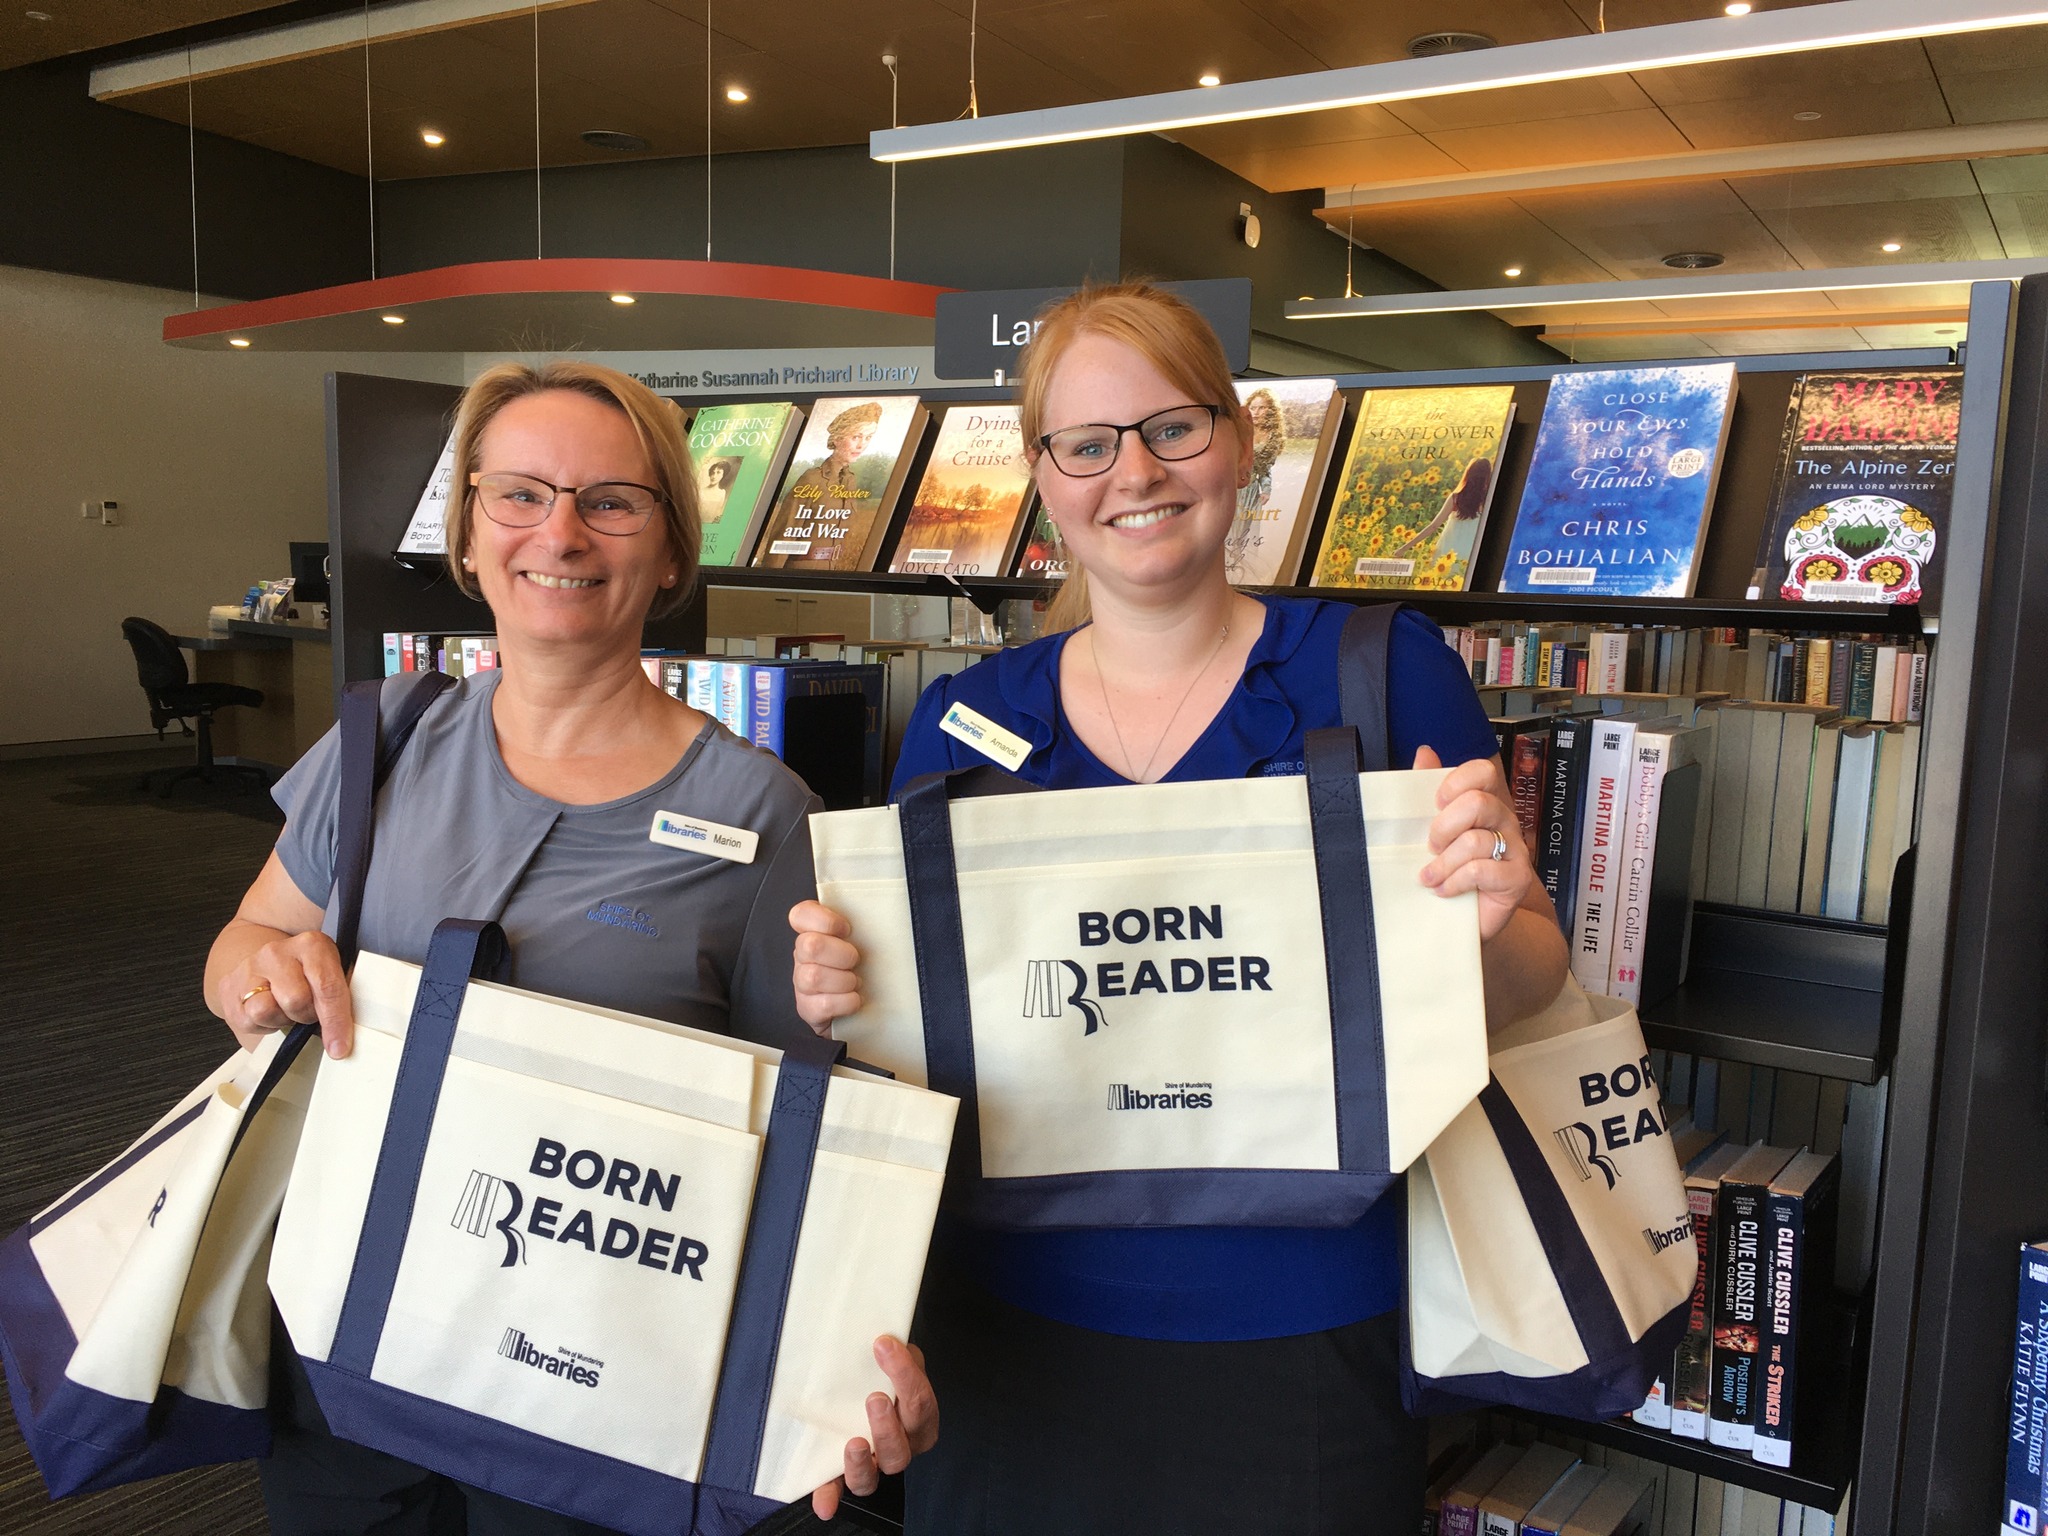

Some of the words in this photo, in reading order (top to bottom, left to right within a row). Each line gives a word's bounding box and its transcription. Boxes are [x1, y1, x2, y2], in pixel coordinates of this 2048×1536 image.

[702, 368, 779, 388] Susannah
[782, 365, 852, 384] Prichard
[857, 364, 919, 384] Library
[1603, 392, 1669, 406] CLOSE
[1832, 381, 1947, 410] MARY
[701, 416, 775, 432] CATHERINE
[966, 415, 1022, 434] Dying
[1425, 408, 1447, 421] the
[1367, 425, 1495, 441] SUNFLOWER
[1570, 420, 1626, 435] YOUR
[691, 430, 776, 449] COOKSON
[970, 435, 993, 448] for
[995, 440, 1004, 448] a
[952, 451, 1012, 466] Cruise
[1401, 446, 1449, 460] GIRL
[1593, 446, 1653, 460] HOLD
[1672, 456, 1702, 464] LARGE
[1671, 463, 1700, 471] PRINT
[1794, 460, 1832, 475] The
[1841, 459, 1908, 478] Alpine
[1571, 466, 1656, 489] Hands
[793, 484, 824, 502] Lily
[828, 485, 872, 499] Baxter
[795, 504, 811, 520] In
[814, 504, 851, 520] Love
[410, 532, 432, 540] BOYD
[783, 522, 814, 538] and
[817, 523, 849, 539] War
[1562, 519, 1649, 537] CHRIS
[1224, 528, 1265, 558] ady's
[1518, 548, 1681, 567] BOHJALIAN
[901, 562, 943, 575] JOYCE
[943, 563, 980, 576] CATO
[1327, 573, 1387, 586] ROSANNA
[1388, 575, 1455, 587] CHIOFALO
[1915, 657, 1924, 675] David
[1541, 674, 1548, 683] ME
[1911, 675, 1922, 712] ARMSTRONG
[949, 711, 984, 740] libraries
[1557, 731, 1575, 740] LARGE
[1556, 739, 1574, 749] PRINT
[1602, 741, 1620, 751] PRINT
[1603, 733, 1621, 742] LARGE
[990, 738, 1019, 758] Amanda
[1639, 747, 1661, 757] LARGE
[1263, 762, 1294, 773] SHIRE
[1296, 761, 1305, 770] O
[1639, 755, 1661, 764] PRINT
[1552, 759, 1568, 819] MARTINA
[1634, 765, 1656, 819] Bobby's
[1525, 777, 1537, 830] COLLEEN
[1593, 776, 1615, 848] MARTINA
[661, 820, 707, 840] libraries
[1548, 822, 1563, 855] COLE
[1634, 823, 1649, 850] Girl
[713, 834, 742, 848] Marion
[1546, 868, 1559, 892] THE
[1589, 853, 1608, 893] COLE
[1628, 857, 1646, 902] Catrin
[1586, 902, 1602, 923] THE
[1078, 904, 1223, 947] BORN
[1623, 906, 1641, 953] Collier
[1040, 956, 1274, 1036] READER
[1185, 1082, 1213, 1090] Mundaring
[1122, 1084, 1213, 1111] libraries
[529, 1137, 682, 1213] BORN
[1688, 1195, 1712, 1204] LARGE
[1689, 1202, 1710, 1213] PRINT
[476, 1177, 709, 1282] READER
[1737, 1221, 1758, 1259] CLIVE
[1775, 1227, 1795, 1269] CLIVE
[1728, 1239, 1737, 1264] DIRK
[1690, 1260, 1707, 1331] CUSSLER
[1725, 1266, 1736, 1311] CUSSLER
[1734, 1262, 1757, 1322] CUSSLER
[1773, 1271, 1792, 1335] CUSSLER
[557, 1346, 571, 1357] Shire
[577, 1353, 605, 1369] Mundaring
[1771, 1344, 1781, 1363] THE
[2016, 1320, 2034, 1376] KATIE
[513, 1333, 600, 1388] libraries
[1722, 1365, 1737, 1404] ARROW
[1735, 1356, 1751, 1416] POSEIDON'S
[1765, 1363, 1785, 1426] STRIKER
[2011, 1379, 2030, 1444] FLYNN
[2027, 1396, 2048, 1475] Christmas
[1446, 1512, 1470, 1524] LARGE
[1484, 1522, 1510, 1536] LARGE
